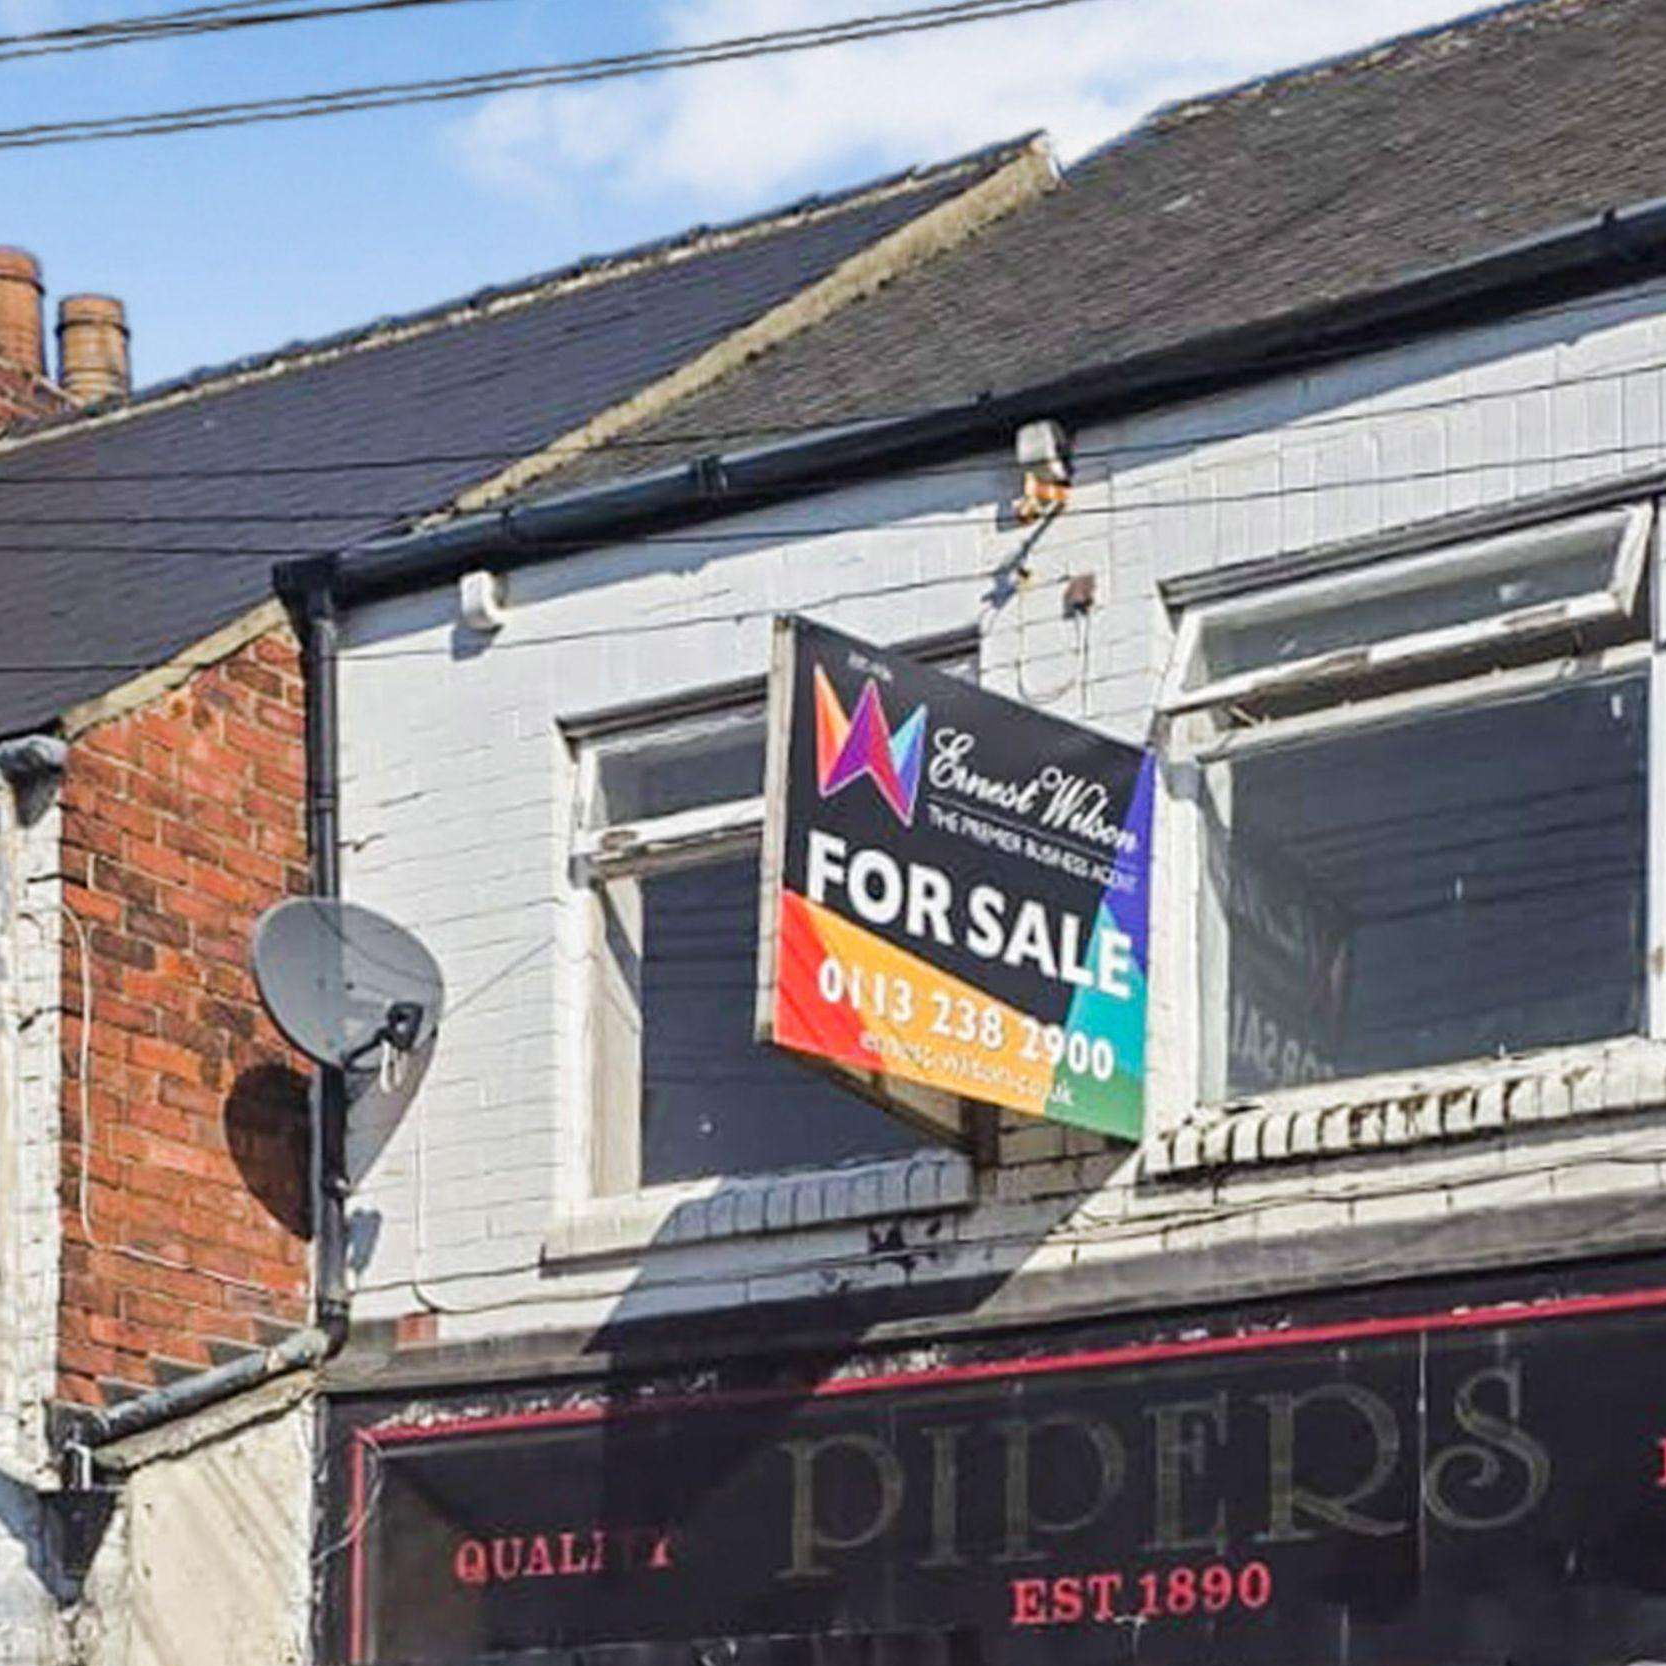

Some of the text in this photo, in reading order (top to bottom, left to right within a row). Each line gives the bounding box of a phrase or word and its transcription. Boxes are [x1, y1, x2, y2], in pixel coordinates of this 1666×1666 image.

[929, 727, 1137, 853] Ernest Wilson
[805, 830, 1132, 1000] FOR SALE
[818, 957, 1115, 1082] 0113 238 2900
[774, 1361, 1553, 1580] PIPERS
[1139, 1561, 1273, 1620] 1890
